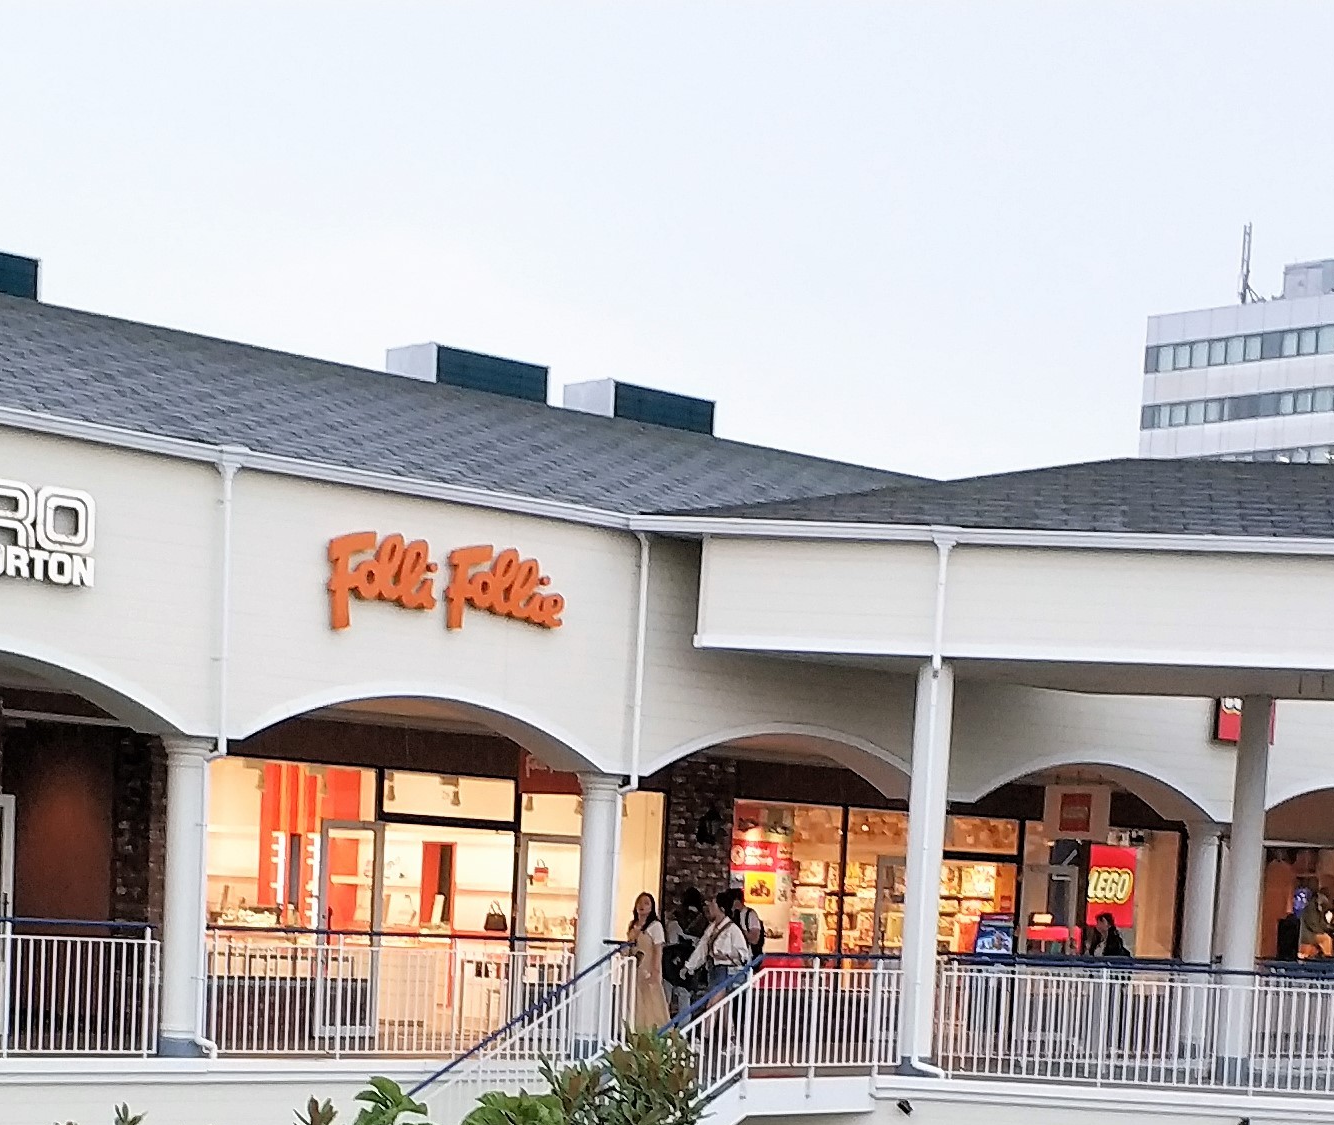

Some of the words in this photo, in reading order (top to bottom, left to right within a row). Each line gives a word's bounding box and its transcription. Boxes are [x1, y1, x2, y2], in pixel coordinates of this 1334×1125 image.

[327, 531, 438, 630] Folli
[443, 545, 565, 630] Follie
[1087, 866, 1134, 904] LEGO
